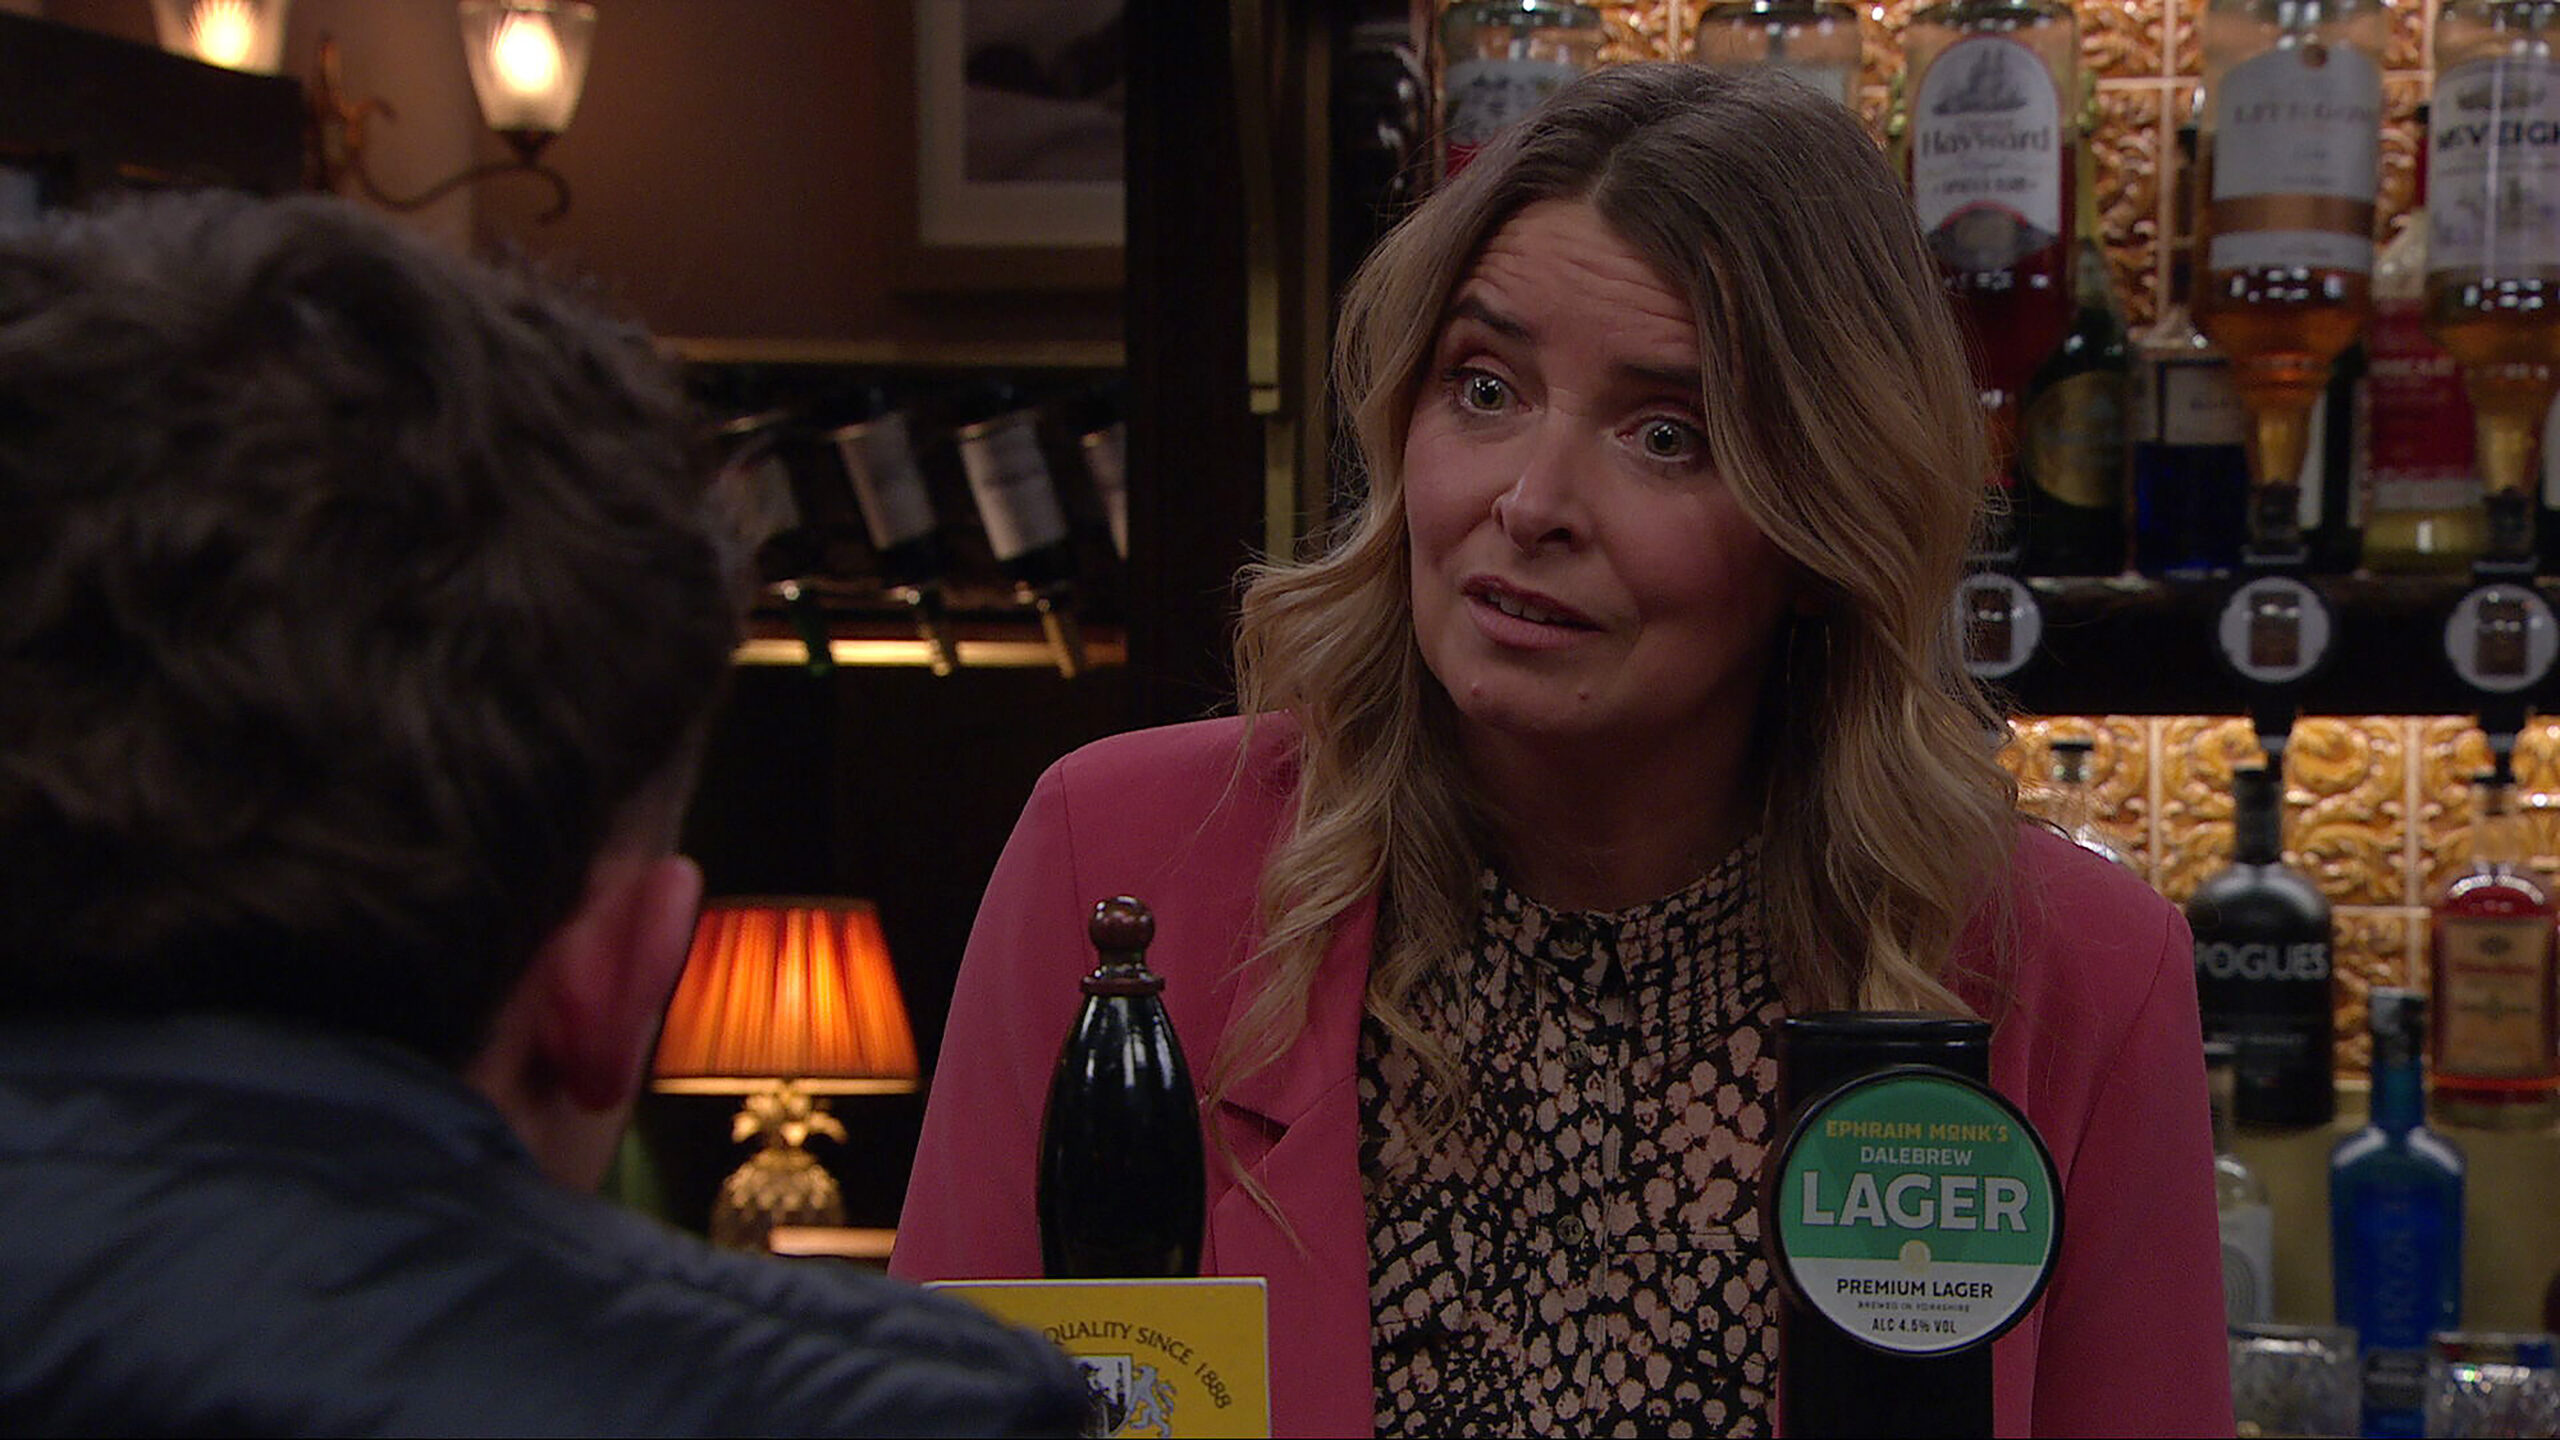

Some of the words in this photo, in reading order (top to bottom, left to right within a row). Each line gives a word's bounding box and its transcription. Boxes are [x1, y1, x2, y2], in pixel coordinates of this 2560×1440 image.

[1921, 126, 2051, 160] Hayward
[1826, 1119, 1921, 1140] EPHRAIM
[1929, 1123, 2008, 1142] MONK'S
[1860, 1145, 1973, 1166] DALEBREW
[1802, 1170, 2029, 1231] LAGER
[1836, 1278, 1926, 1297] PREMIUM
[1932, 1281, 1993, 1299] LAGER
[1872, 1318, 1895, 1332] ALC
[1899, 1319, 1930, 1333] 4.5%
[1934, 1319, 1957, 1334] VOL
[1042, 1321, 1134, 1346] QUALITY
[1136, 1327, 1196, 1366] SINCE
[1194, 1361, 1233, 1410] 1888
